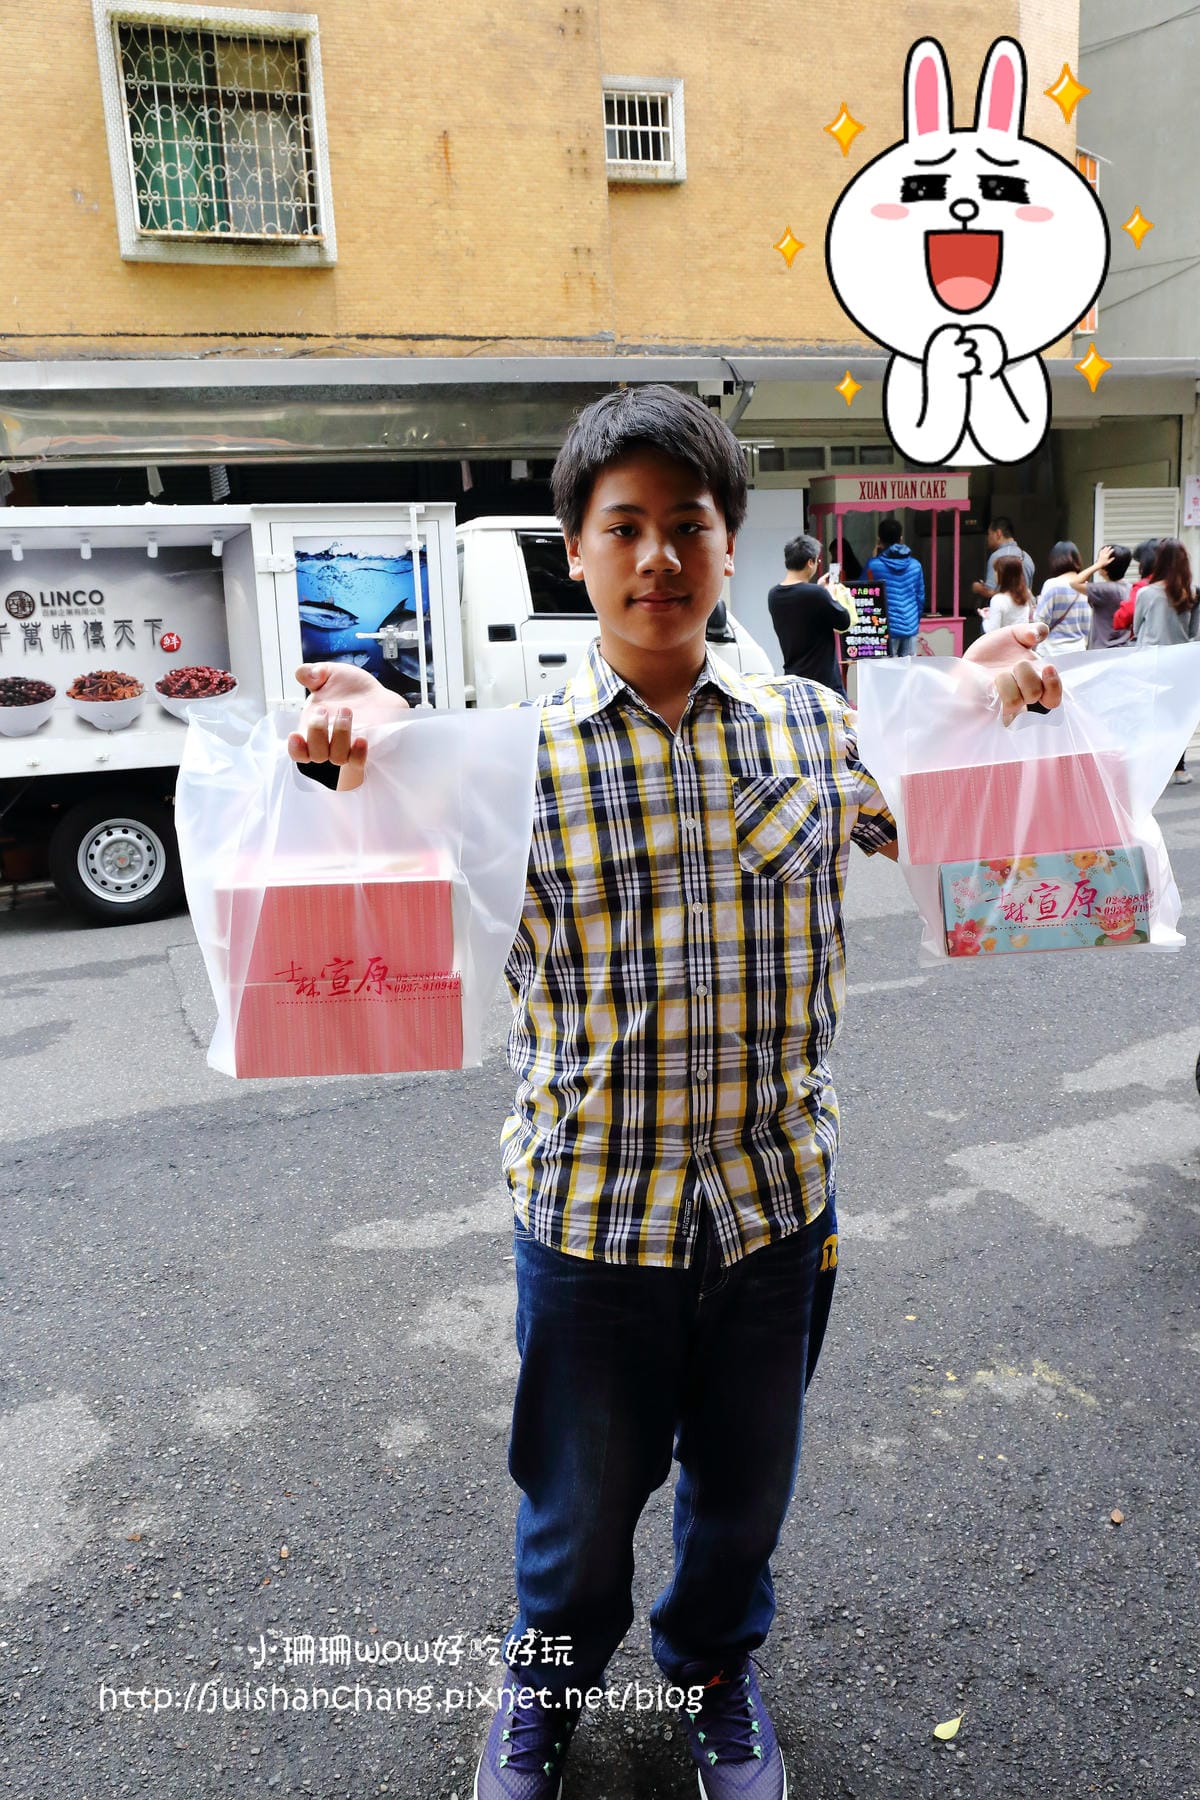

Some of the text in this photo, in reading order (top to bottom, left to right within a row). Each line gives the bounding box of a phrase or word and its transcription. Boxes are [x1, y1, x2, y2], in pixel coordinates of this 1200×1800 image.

[859, 480, 946, 499] XUAN YUAN CAKE
[40, 590, 104, 607] LINCO
